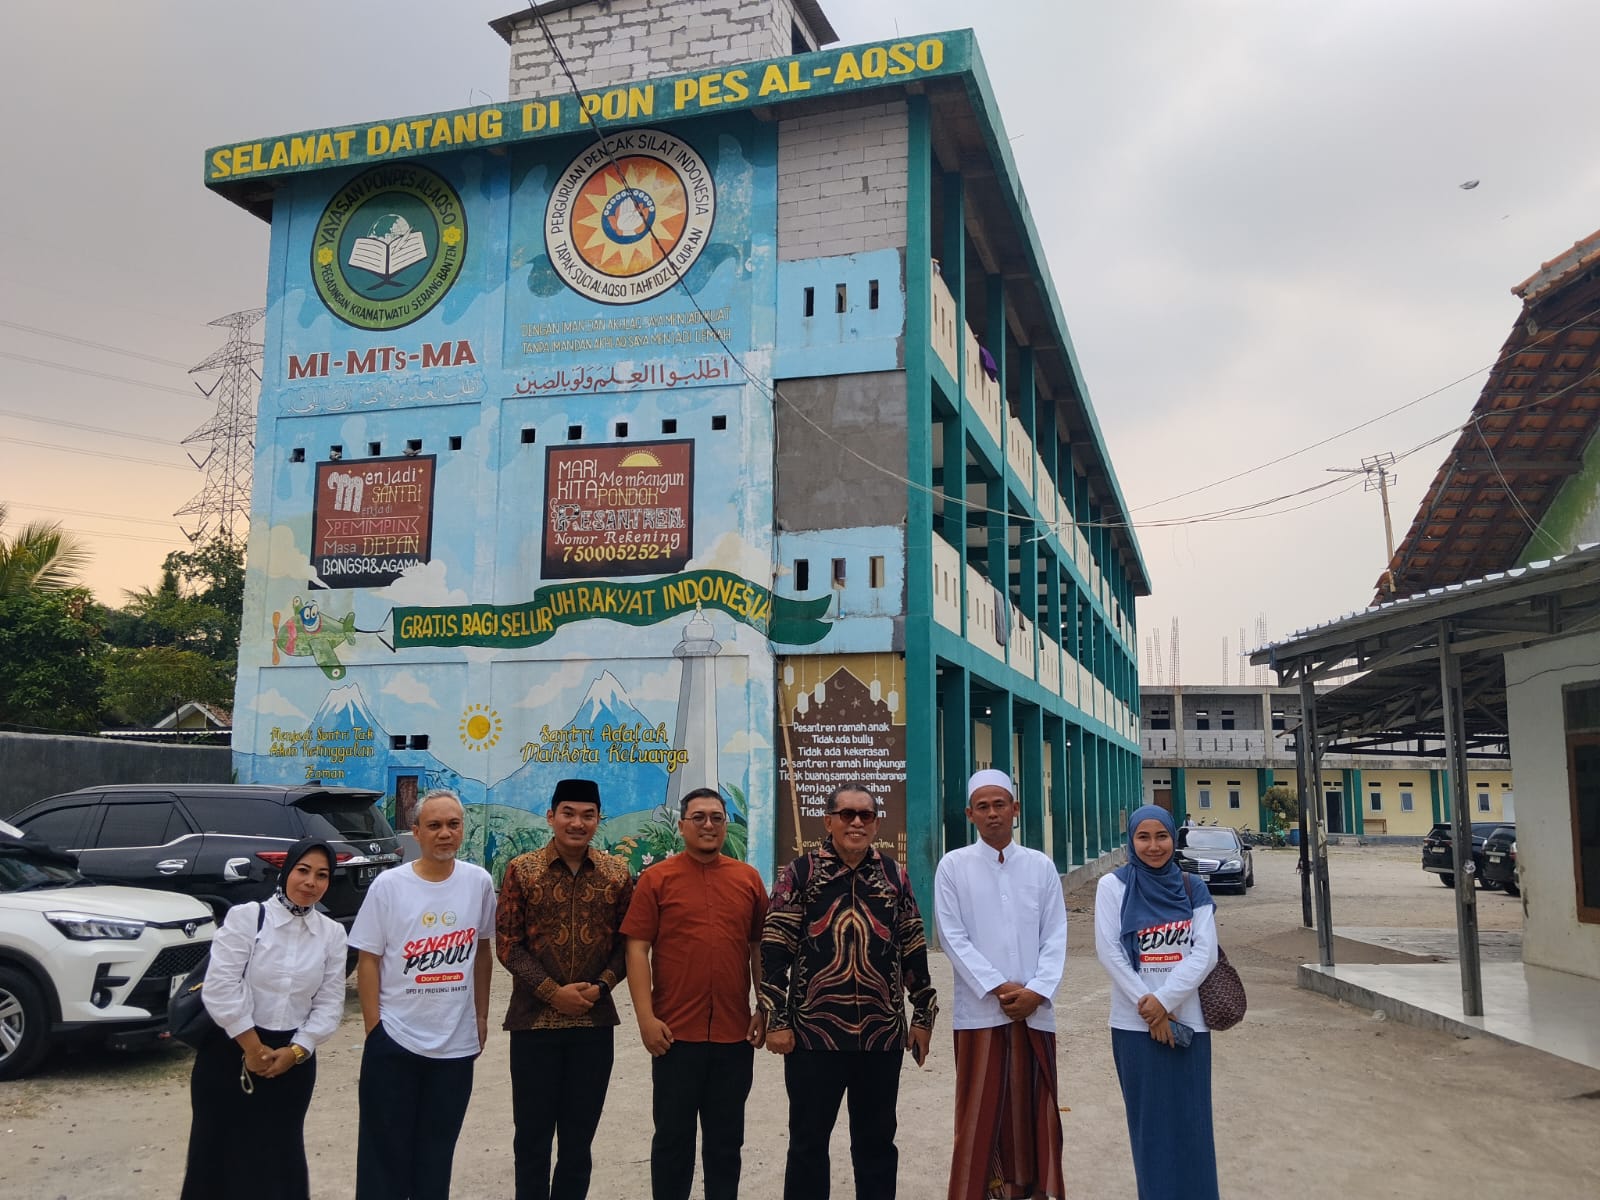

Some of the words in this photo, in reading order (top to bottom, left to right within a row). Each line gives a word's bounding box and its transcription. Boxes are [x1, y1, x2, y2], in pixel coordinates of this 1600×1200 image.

[211, 131, 356, 179] SELAMAT
[366, 109, 503, 157] DATANG
[521, 100, 560, 132] DI
[579, 85, 654, 124] PON
[674, 70, 749, 110] PES
[551, 164, 586, 236] PERGURUAN
[585, 135, 635, 169] PENCAK
[638, 134, 679, 156] SILAT
[675, 149, 710, 216] INDONESIA
[319, 184, 365, 247] YAYASAN
[365, 169, 417, 193] PONPES
[554, 240, 579, 276] TAPAK
[571, 267, 592, 289] SUCI
[321, 264, 350, 309] PEGADINGAN
[412, 278, 443, 311] SERANG
[437, 245, 457, 285] BANTEN
[558, 460, 597, 479] MARI
[599, 471, 685, 493] Membangun
[558, 480, 598, 499] KITA
[597, 487, 659, 506] PONDOK
[333, 519, 411, 536] PEMIMPIN
[323, 541, 357, 555] Masa
[362, 535, 420, 557] DEPAN
[555, 532, 598, 545] Nomor
[604, 531, 680, 549] Rekening
[563, 543, 672, 563] 7500052524
[401, 614, 458, 638] GRATIS
[461, 612, 498, 636] BAGI
[577, 587, 656, 615] RAKYAT
[663, 576, 769, 620] INDONESIA
[540, 724, 594, 743] Santri
[600, 722, 668, 743] Adalah
[793, 722, 836, 732] Pesantren
[838, 723, 866, 732] ramah
[867, 722, 890, 732] anak
[811, 734, 834, 744] Tidak
[835, 735, 851, 744] ada
[852, 734, 873, 746] bully
[520, 742, 600, 763] Mahkota
[608, 743, 689, 773] Keluarga
[798, 746, 822, 756] Tidak
[824, 747, 840, 756] ada
[844, 747, 889, 757] kekerasan
[305, 764, 345, 779] Zaman
[830, 758, 861, 768] ramah
[804, 770, 830, 782] buang
[830, 770, 860, 782] sampah
[796, 783, 836, 794] Menjaga
[800, 795, 826, 805] Tidak
[800, 807, 825, 817] Tidak
[402, 927, 476, 960] SENATOR
[1138, 928, 1190, 951] EDULI
[403, 942, 473, 975] PEDULI
